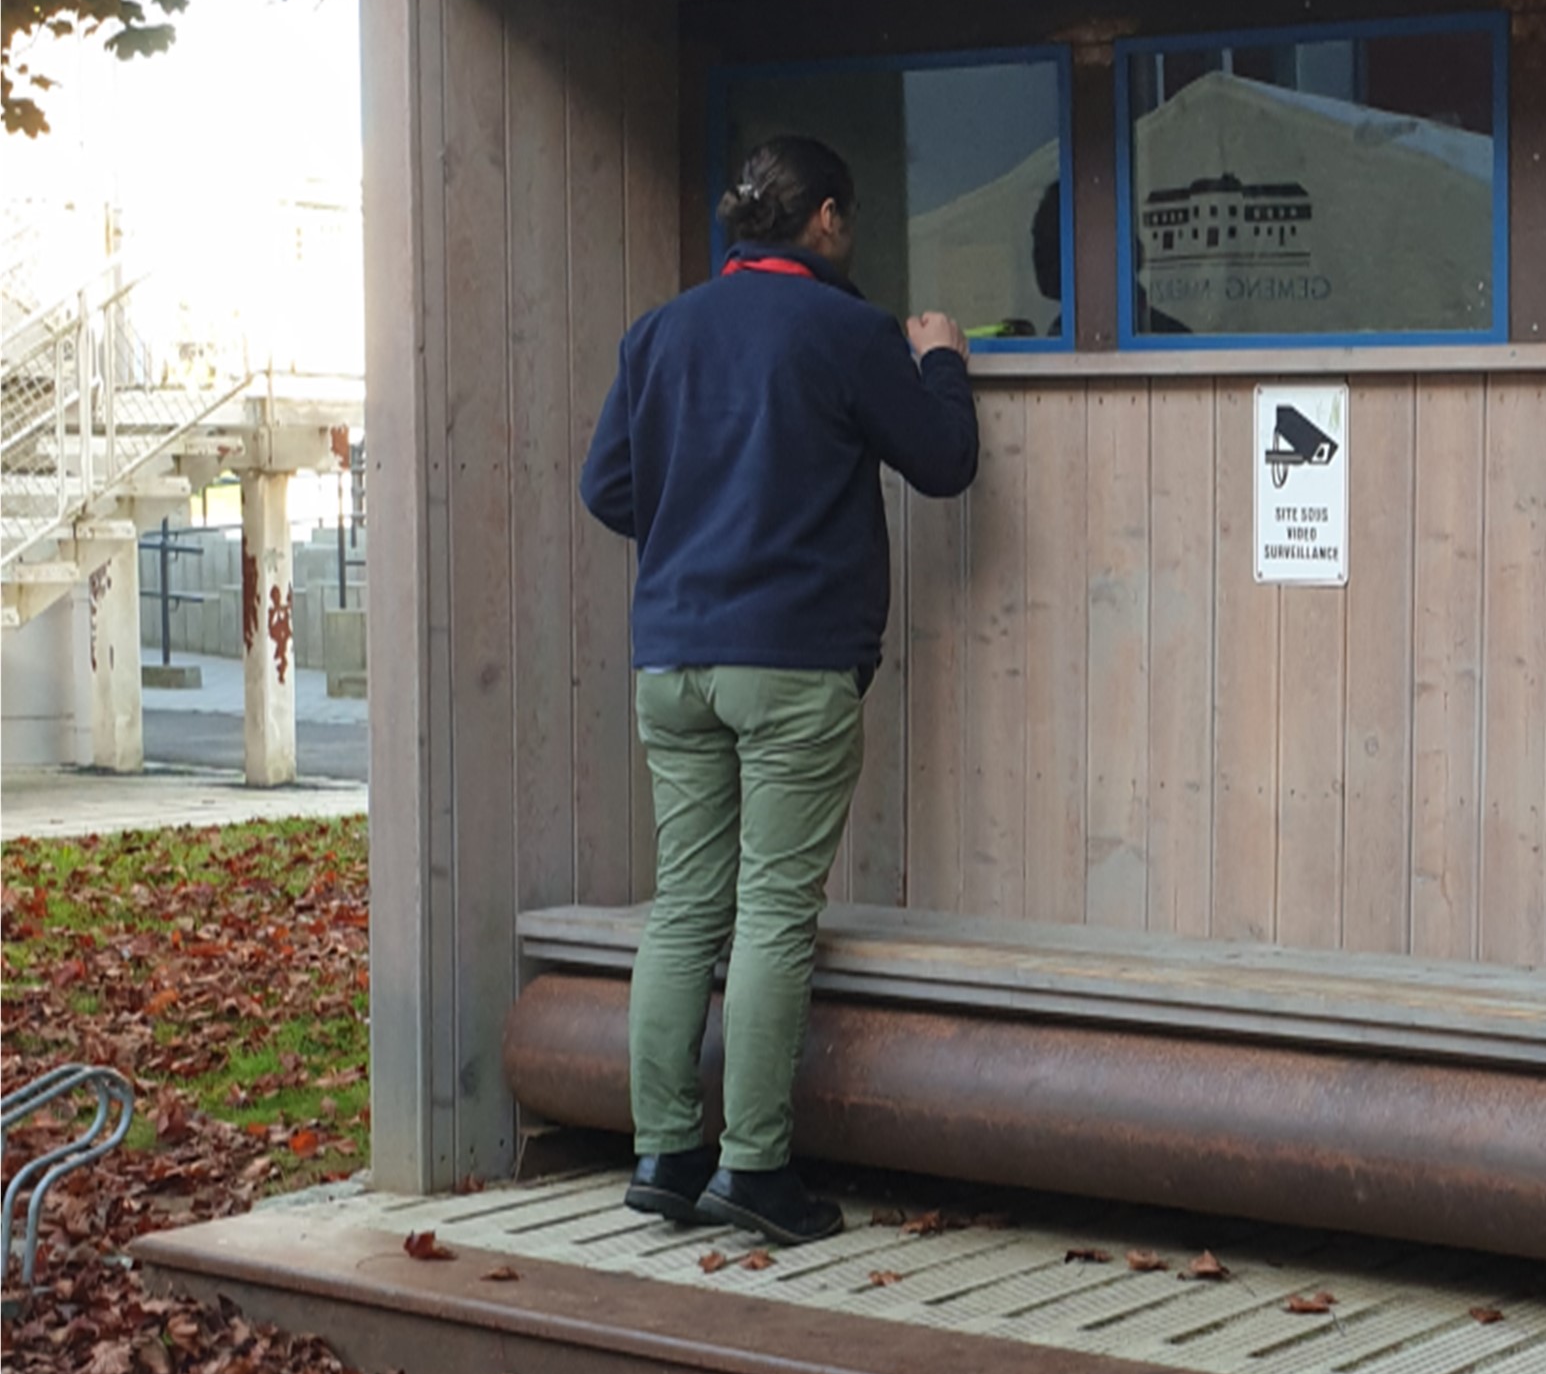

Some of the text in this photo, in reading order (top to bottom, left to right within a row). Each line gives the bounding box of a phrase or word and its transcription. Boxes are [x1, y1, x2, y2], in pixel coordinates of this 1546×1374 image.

[1276, 508, 1328, 522] SITE SOUS
[1287, 528, 1317, 541] VIDEO
[1265, 545, 1338, 561] SURVEILLANCE
